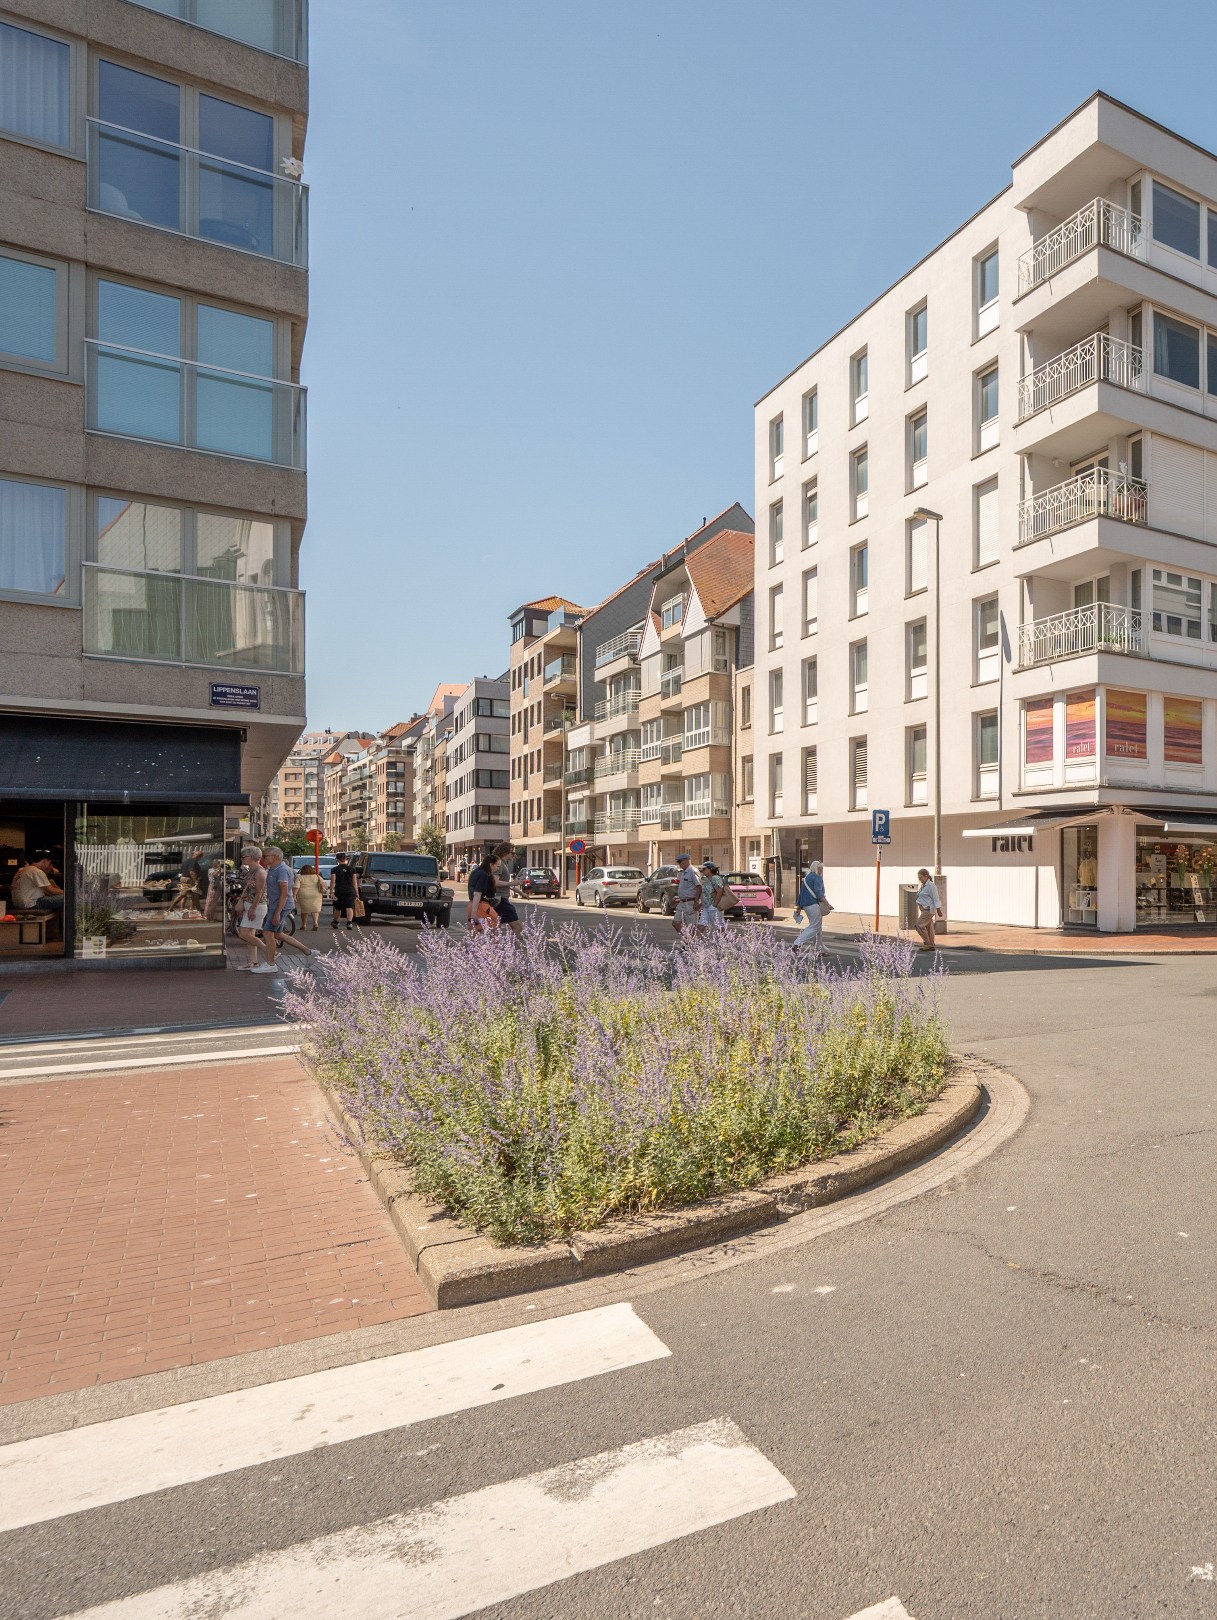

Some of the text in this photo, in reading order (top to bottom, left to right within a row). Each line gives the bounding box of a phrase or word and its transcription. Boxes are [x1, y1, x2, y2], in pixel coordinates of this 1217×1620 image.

[213, 686, 257, 695] LIPPENSLAAN
[1072, 741, 1090, 753] ralet
[1114, 741, 1138, 753] ralet
[875, 813, 886, 832] P
